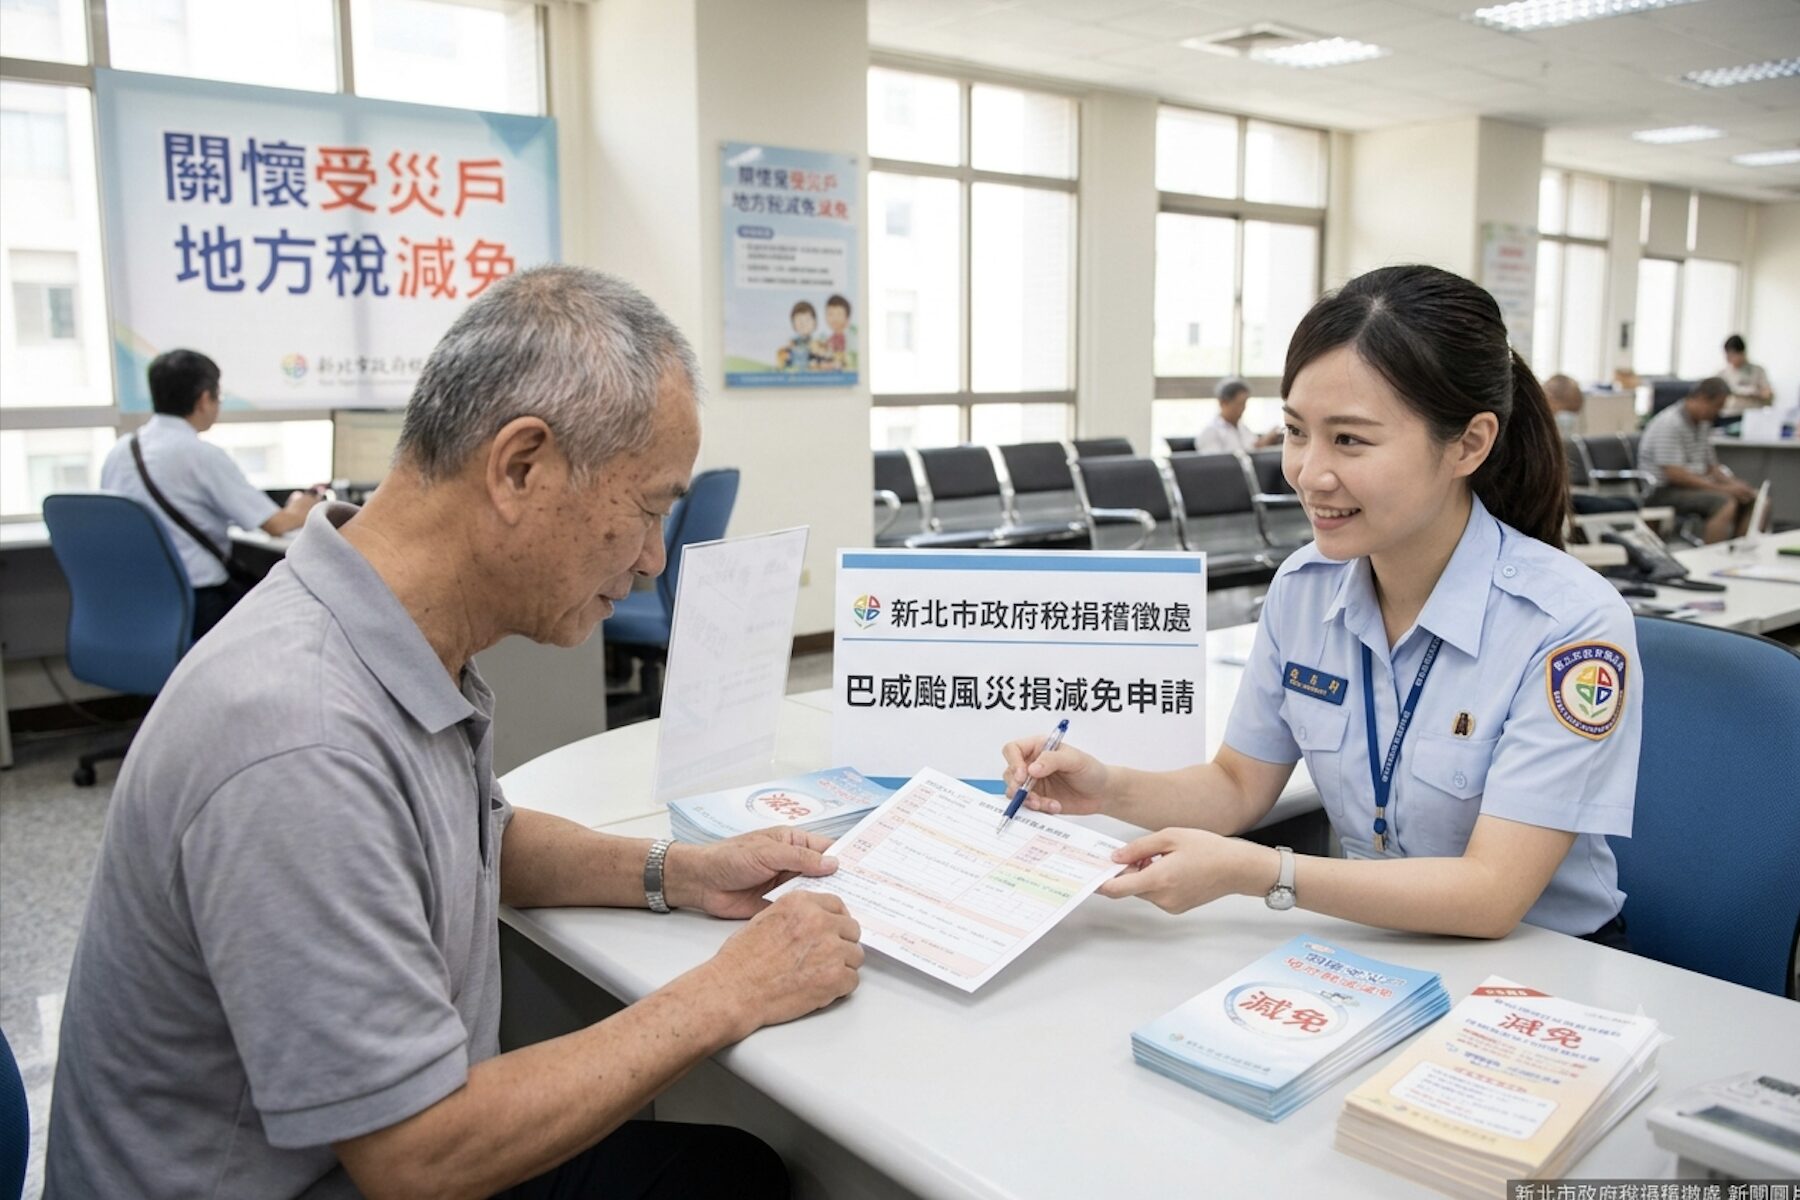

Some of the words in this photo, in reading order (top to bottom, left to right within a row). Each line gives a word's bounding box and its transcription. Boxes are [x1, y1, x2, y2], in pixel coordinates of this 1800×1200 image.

[163, 132, 506, 218] 關懷受災戶
[174, 224, 515, 300] 地方稅減免
[891, 599, 1191, 633] 新北市政府稅捐稽徵處
[846, 674, 1195, 715] 巴威颱風災損減免申請
[1238, 990, 1329, 1033] 減免
[1497, 1012, 1583, 1050] 減免
